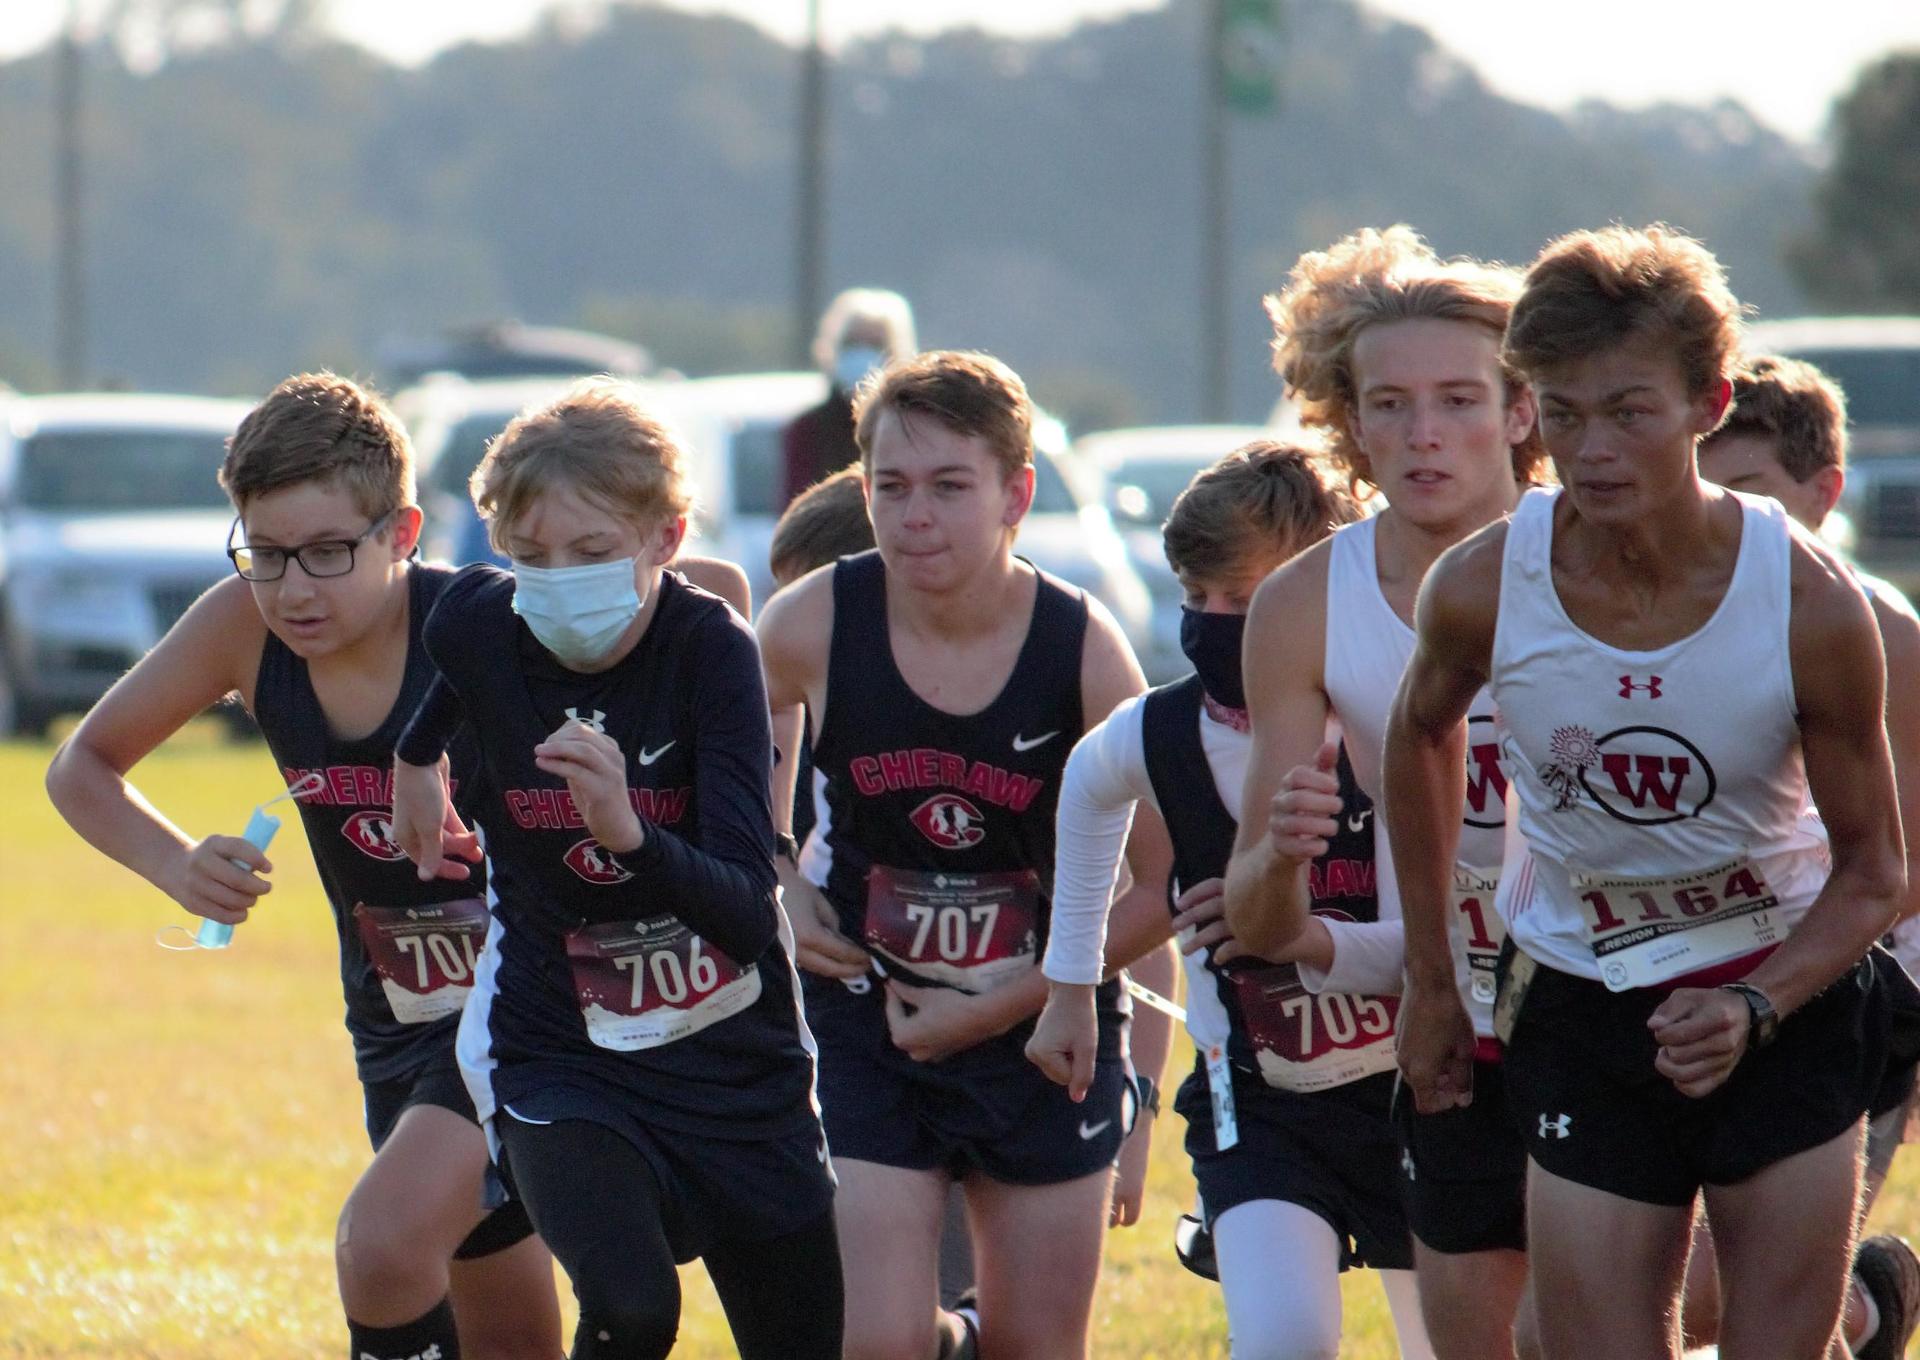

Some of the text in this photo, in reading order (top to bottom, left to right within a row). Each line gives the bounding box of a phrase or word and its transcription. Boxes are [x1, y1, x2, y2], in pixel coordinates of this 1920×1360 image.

[505, 786, 693, 829] CHEW
[850, 748, 1044, 812] CHERAW
[1602, 753, 1691, 811] W
[1580, 867, 1766, 934] 1164
[906, 902, 999, 961] 707
[1604, 926, 1655, 951] REGION
[613, 935, 718, 1009] 706
[1281, 992, 1390, 1055] 705
